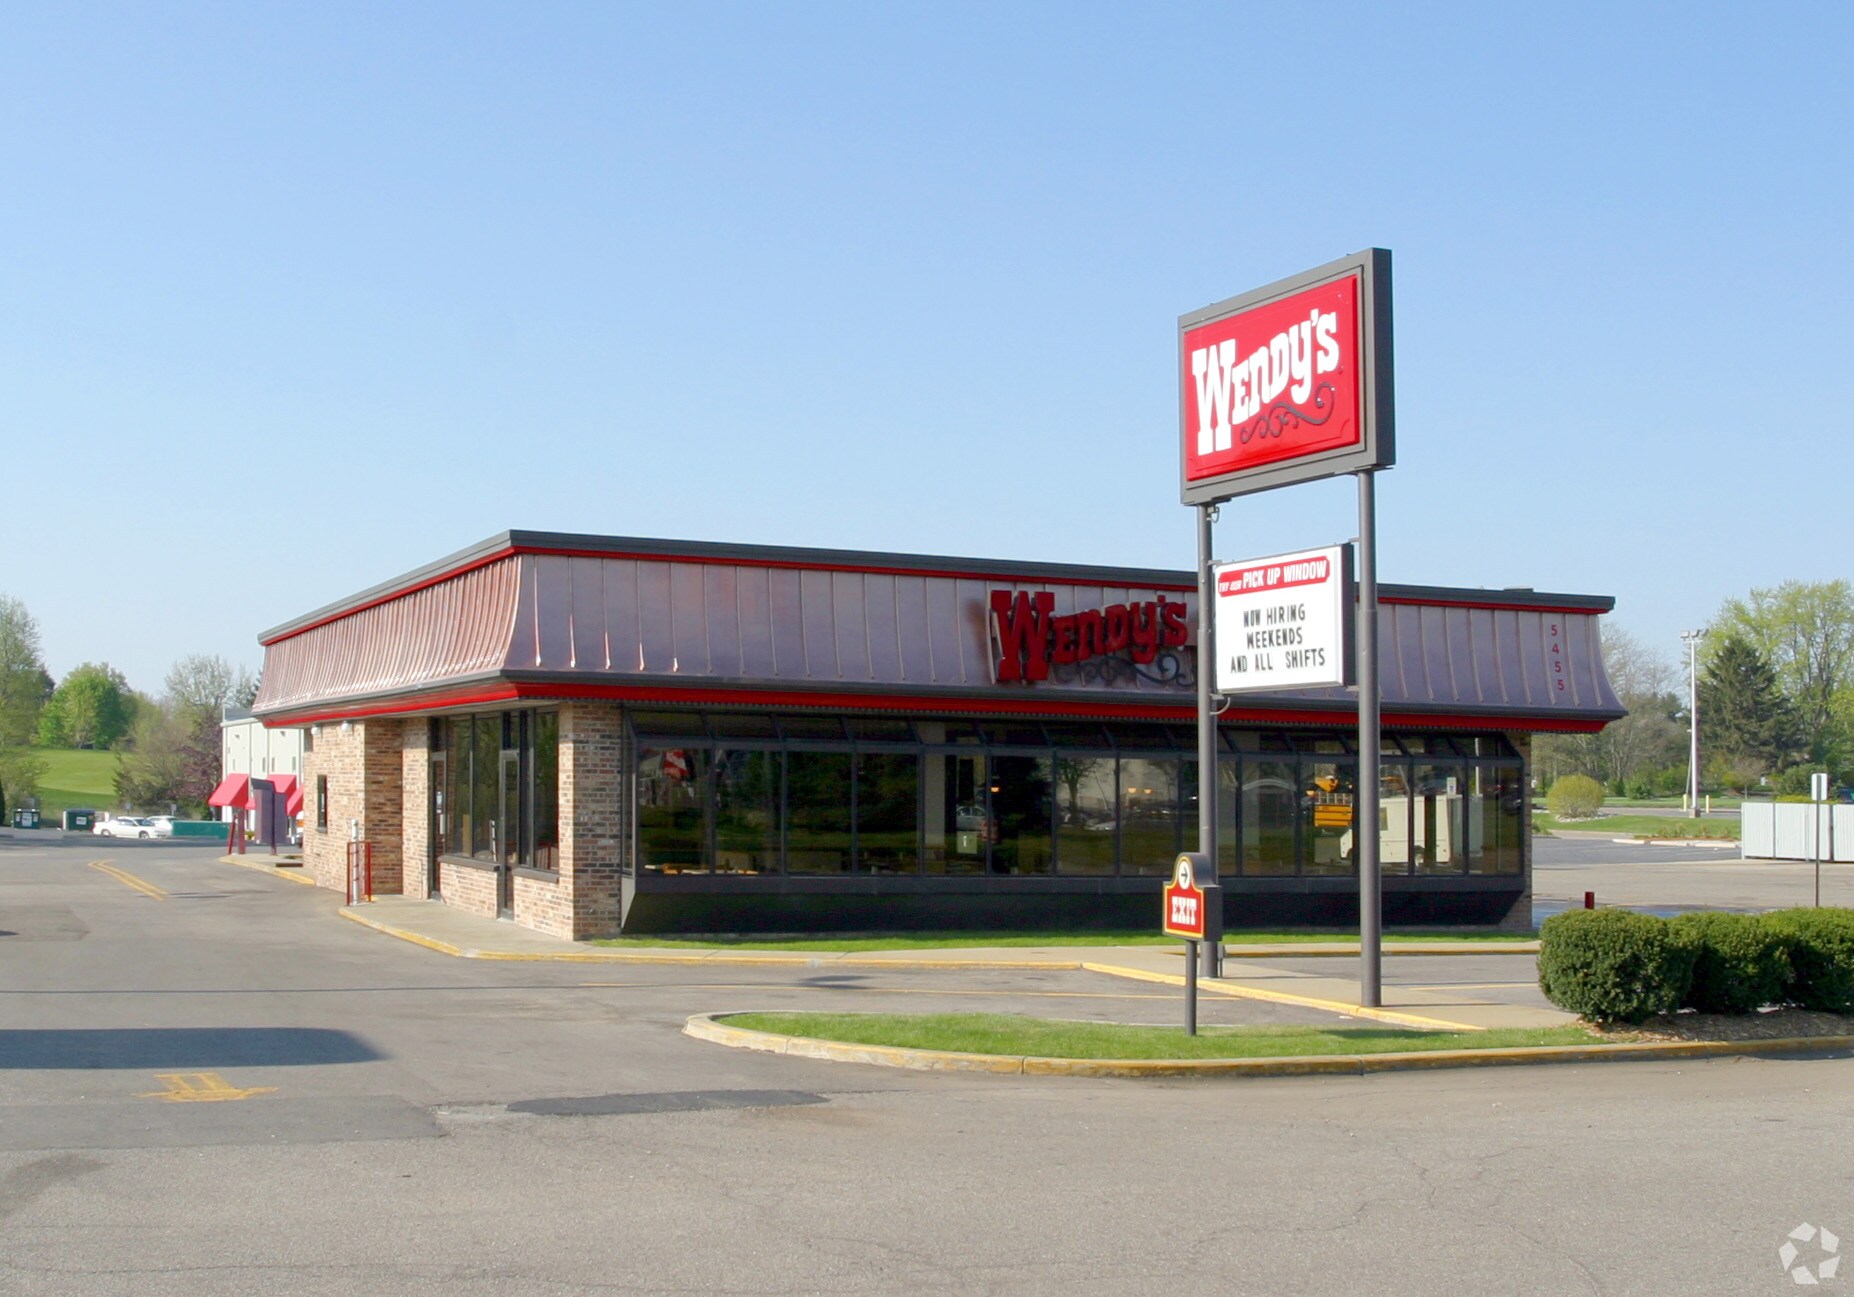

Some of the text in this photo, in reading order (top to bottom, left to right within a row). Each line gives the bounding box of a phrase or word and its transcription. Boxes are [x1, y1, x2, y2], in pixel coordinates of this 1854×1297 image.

[1243, 569, 1264, 589] PICK
[1267, 567, 1280, 585] UP
[1283, 559, 1327, 583] WINDOW
[1243, 603, 1305, 628] NOW HIRING
[1246, 626, 1303, 650] WEEKENDS
[1230, 647, 1325, 673] AND ALL SHIFTS
[1171, 896, 1197, 926] EXIT
